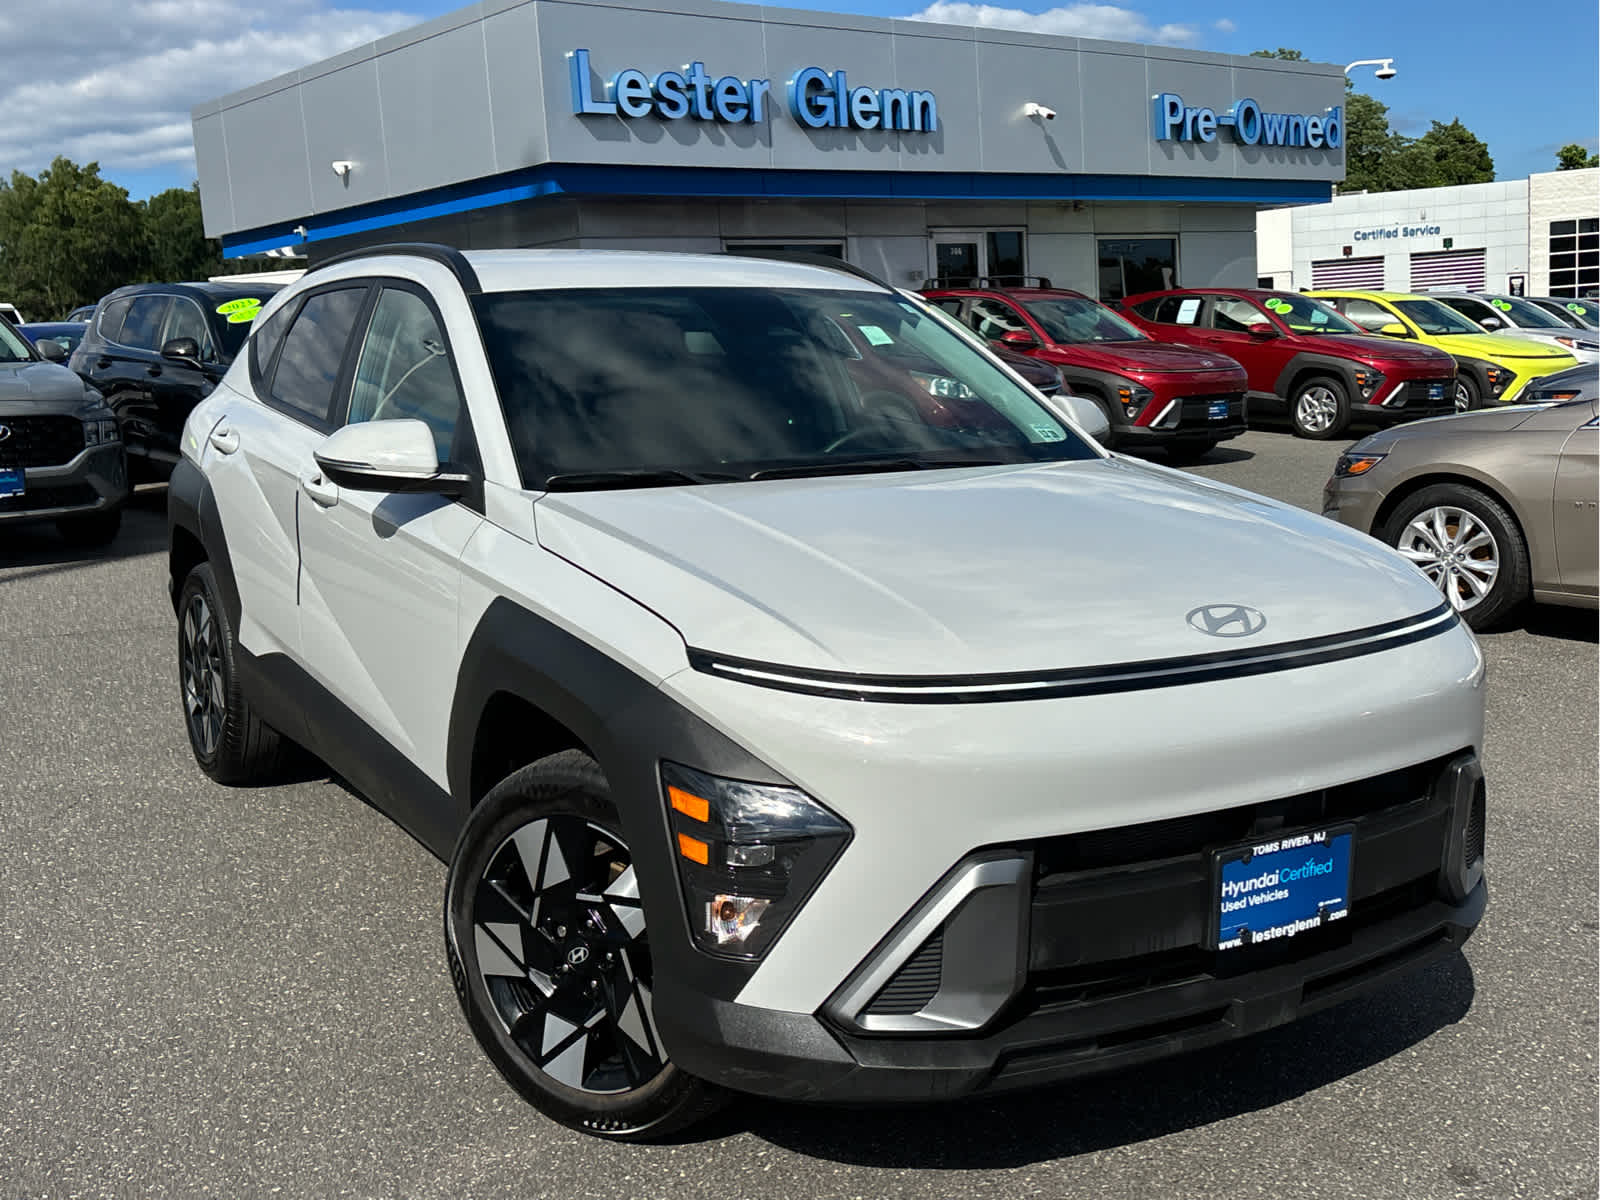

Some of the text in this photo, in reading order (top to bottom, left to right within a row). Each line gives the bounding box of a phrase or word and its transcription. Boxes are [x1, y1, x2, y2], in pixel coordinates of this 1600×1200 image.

[569, 48, 937, 132] Lester Glenn
[1154, 93, 1342, 148] Pre-Owned
[1354, 225, 1441, 241] Certified Service
[1253, 842, 1280, 856] TOMS
[1313, 832, 1326, 843] NJ
[1221, 889, 1289, 913] Used Vehicles
